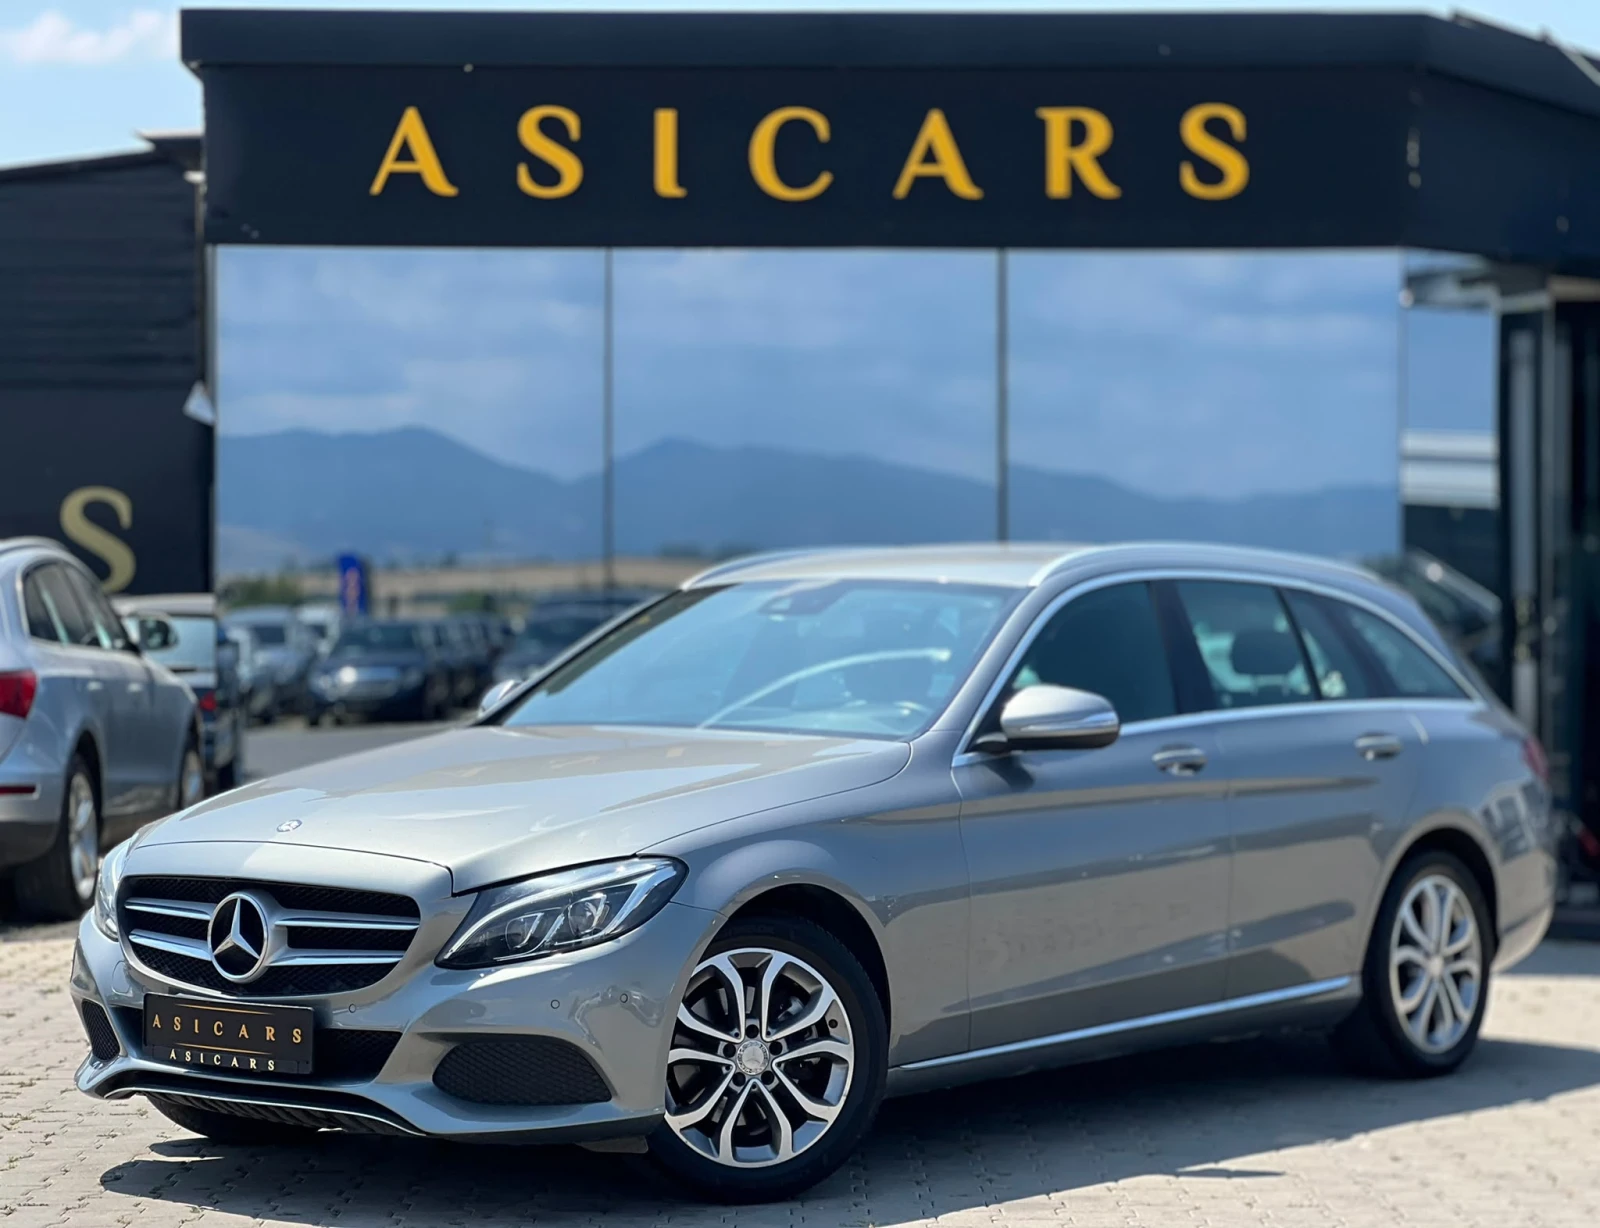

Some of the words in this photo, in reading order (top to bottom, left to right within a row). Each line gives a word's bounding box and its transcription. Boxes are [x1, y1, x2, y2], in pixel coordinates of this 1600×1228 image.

[370, 103, 1249, 201] ASICARS
[152, 1014, 302, 1043] ASICARS
[169, 1048, 275, 1071] ASICARS
